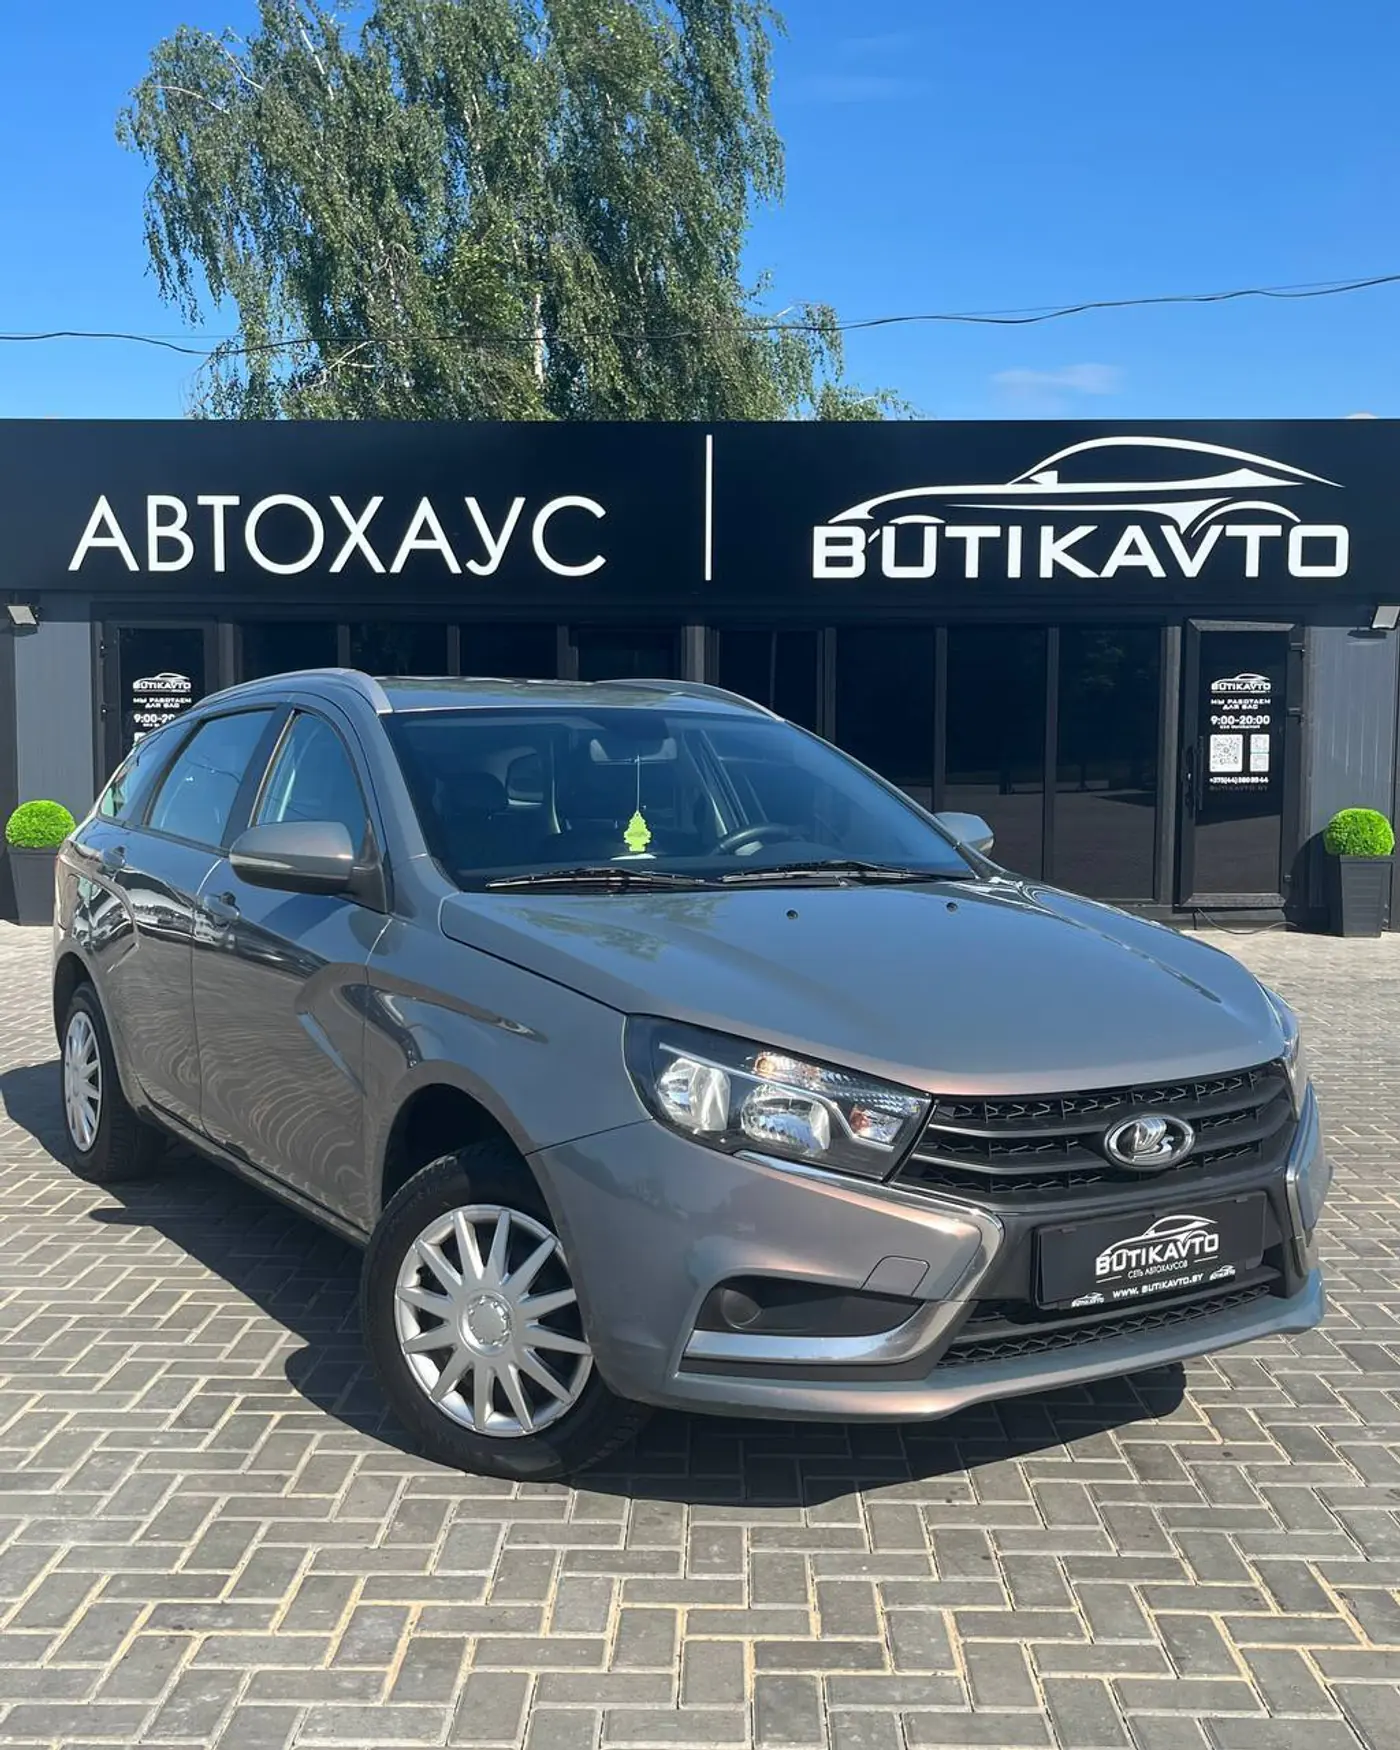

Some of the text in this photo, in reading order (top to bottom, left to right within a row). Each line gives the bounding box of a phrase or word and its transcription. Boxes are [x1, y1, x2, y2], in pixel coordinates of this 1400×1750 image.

[68, 494, 606, 576] АВТОХАУС
[813, 525, 1349, 578] BUTIKAVTO
[1210, 715, 1270, 725] 9:00-20:00
[1096, 1233, 1219, 1275] BUTIKAVTO
